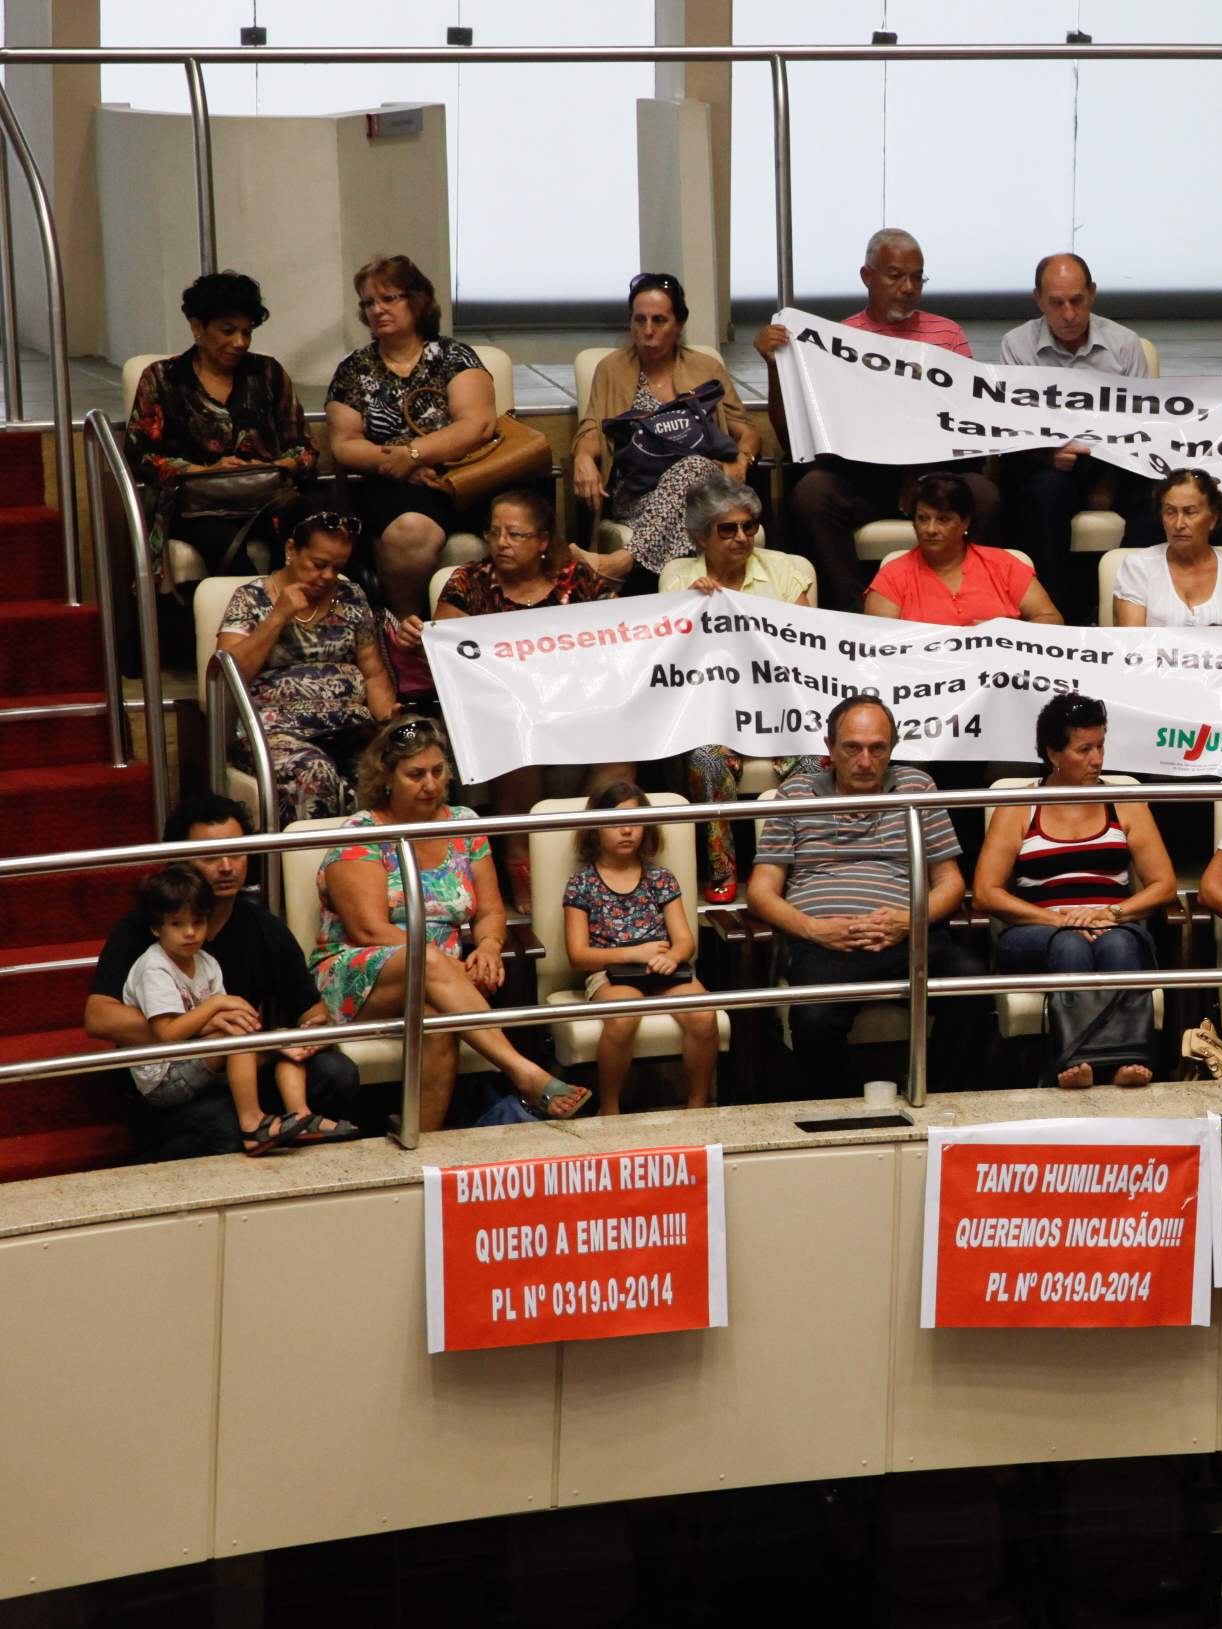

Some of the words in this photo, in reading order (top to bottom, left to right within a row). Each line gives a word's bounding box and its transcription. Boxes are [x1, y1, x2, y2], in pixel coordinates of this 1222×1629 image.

[797, 327, 953, 388] Abono
[972, 375, 1208, 420] Natalino,
[937, 411, 1151, 444] também
[457, 639, 481, 660] O
[494, 616, 693, 661] aposentado
[701, 610, 827, 650] também
[838, 638, 913, 661] quer
[923, 634, 1113, 666] comemorar
[1125, 652, 1143, 667] o
[650, 660, 740, 688] Abono
[751, 659, 880, 698] Natalino
[893, 678, 966, 704] para
[979, 669, 1080, 694] todos!
[457, 1164, 536, 1203] BAIXOU
[544, 1158, 612, 1196] MINHA
[976, 1163, 1039, 1194] TANTO
[1041, 1158, 1169, 1200] HUMILHAÇÃO
[476, 1224, 548, 1264] QUERO
[555, 1222, 570, 1255] A
[577, 1212, 688, 1254] EMENDA!!!!
[956, 1217, 1062, 1250] QUEREMOS
[1065, 1211, 1185, 1248] INCLUSÃO!!!!
[492, 1287, 517, 1322] PL
[553, 1272, 673, 1316] 0319.0-2014
[985, 1272, 1009, 1302] PL
[1040, 1271, 1152, 1302] 0319.0-2014
